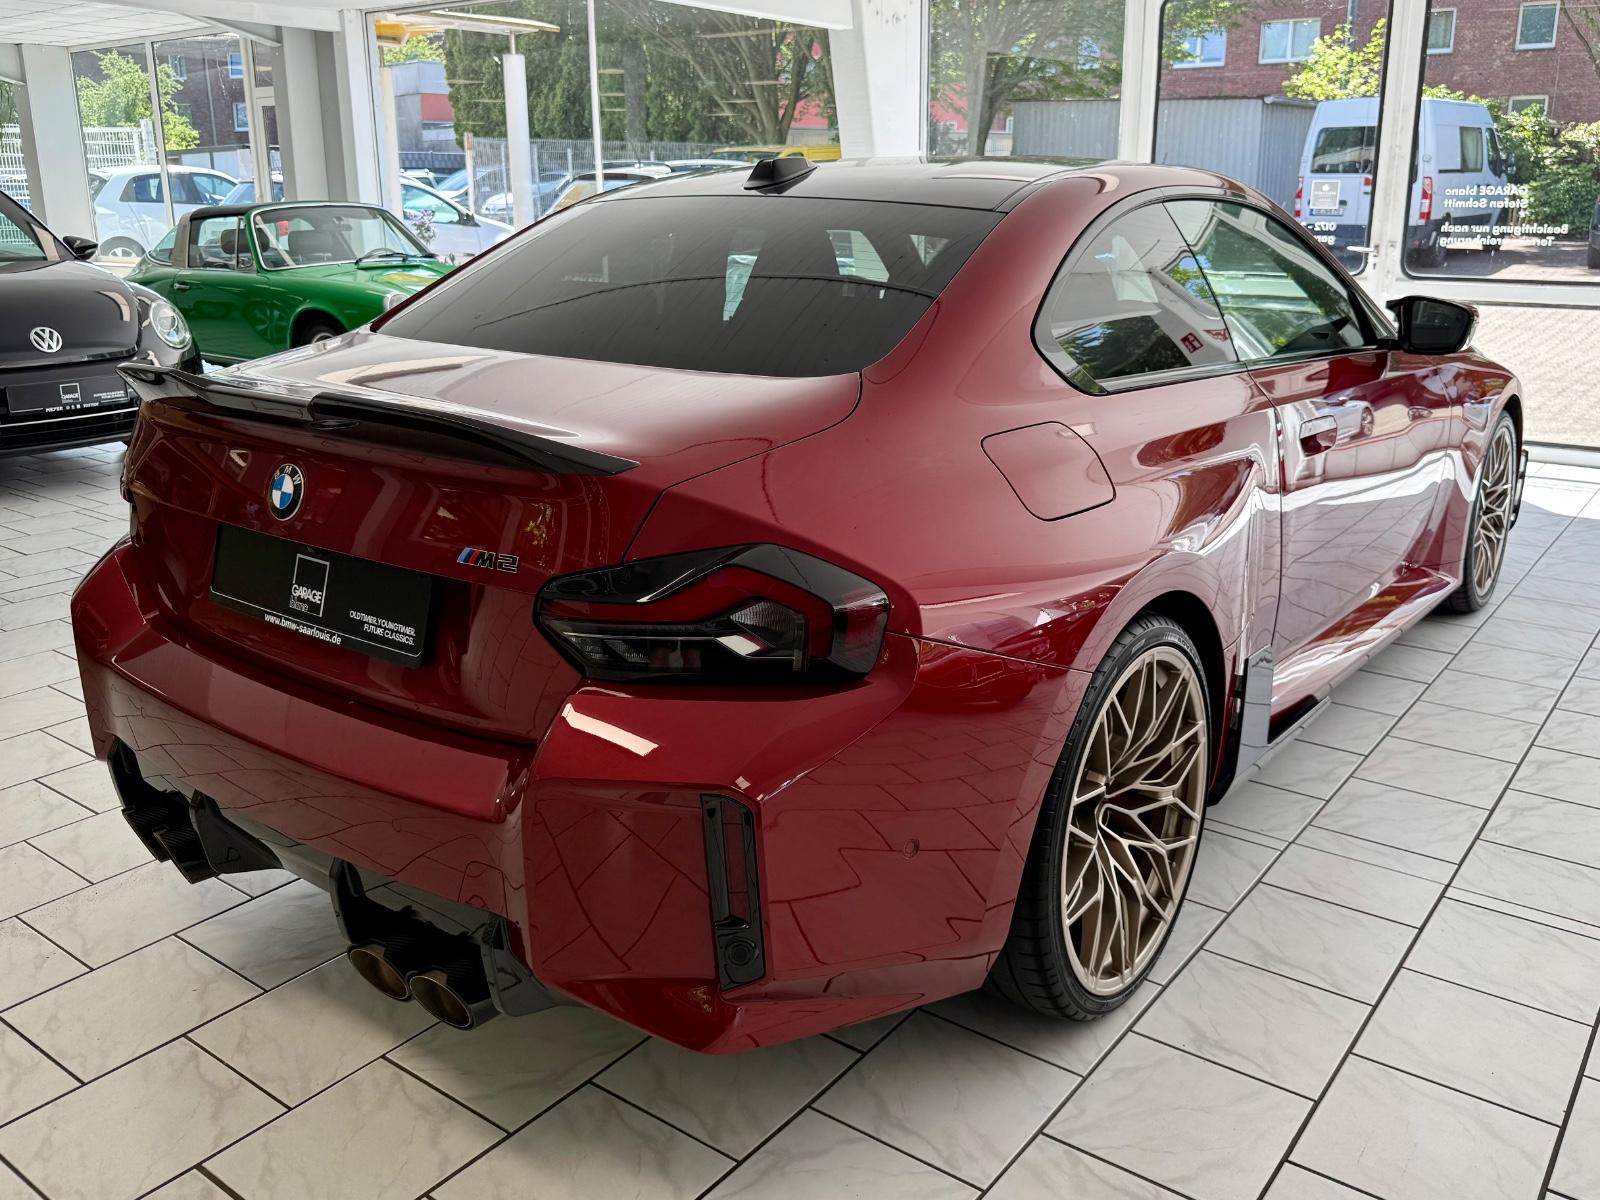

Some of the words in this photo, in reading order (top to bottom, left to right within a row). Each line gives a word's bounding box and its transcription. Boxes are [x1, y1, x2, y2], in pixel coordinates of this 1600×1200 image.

[472, 549, 519, 574] M2
[291, 584, 322, 604] GARAGE
[264, 613, 342, 645] www.bmw-saarlouis.de
[363, 623, 384, 637] FUTURE
[384, 630, 415, 646] CLASSICS.
